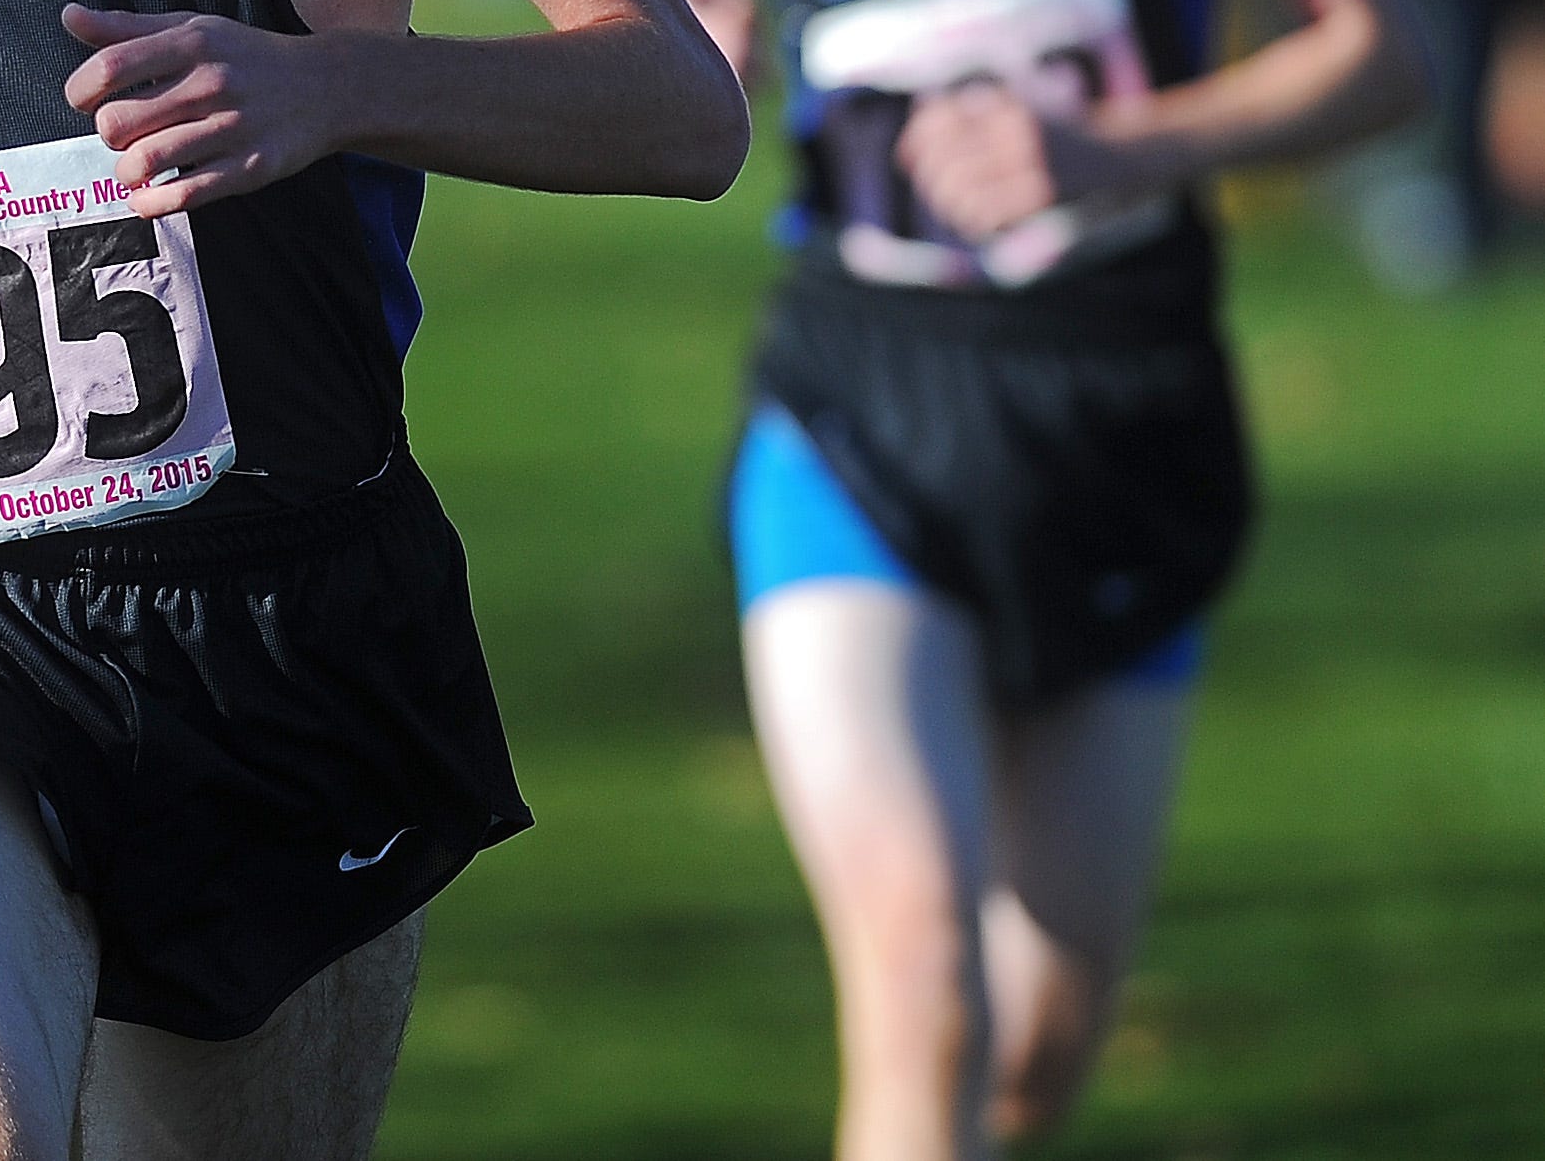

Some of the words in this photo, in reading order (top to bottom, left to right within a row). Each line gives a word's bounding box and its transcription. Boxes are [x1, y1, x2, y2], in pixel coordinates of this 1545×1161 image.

[92, 178, 152, 205] Me
[103, 468, 143, 504] 24,
[152, 454, 212, 491] 2015
